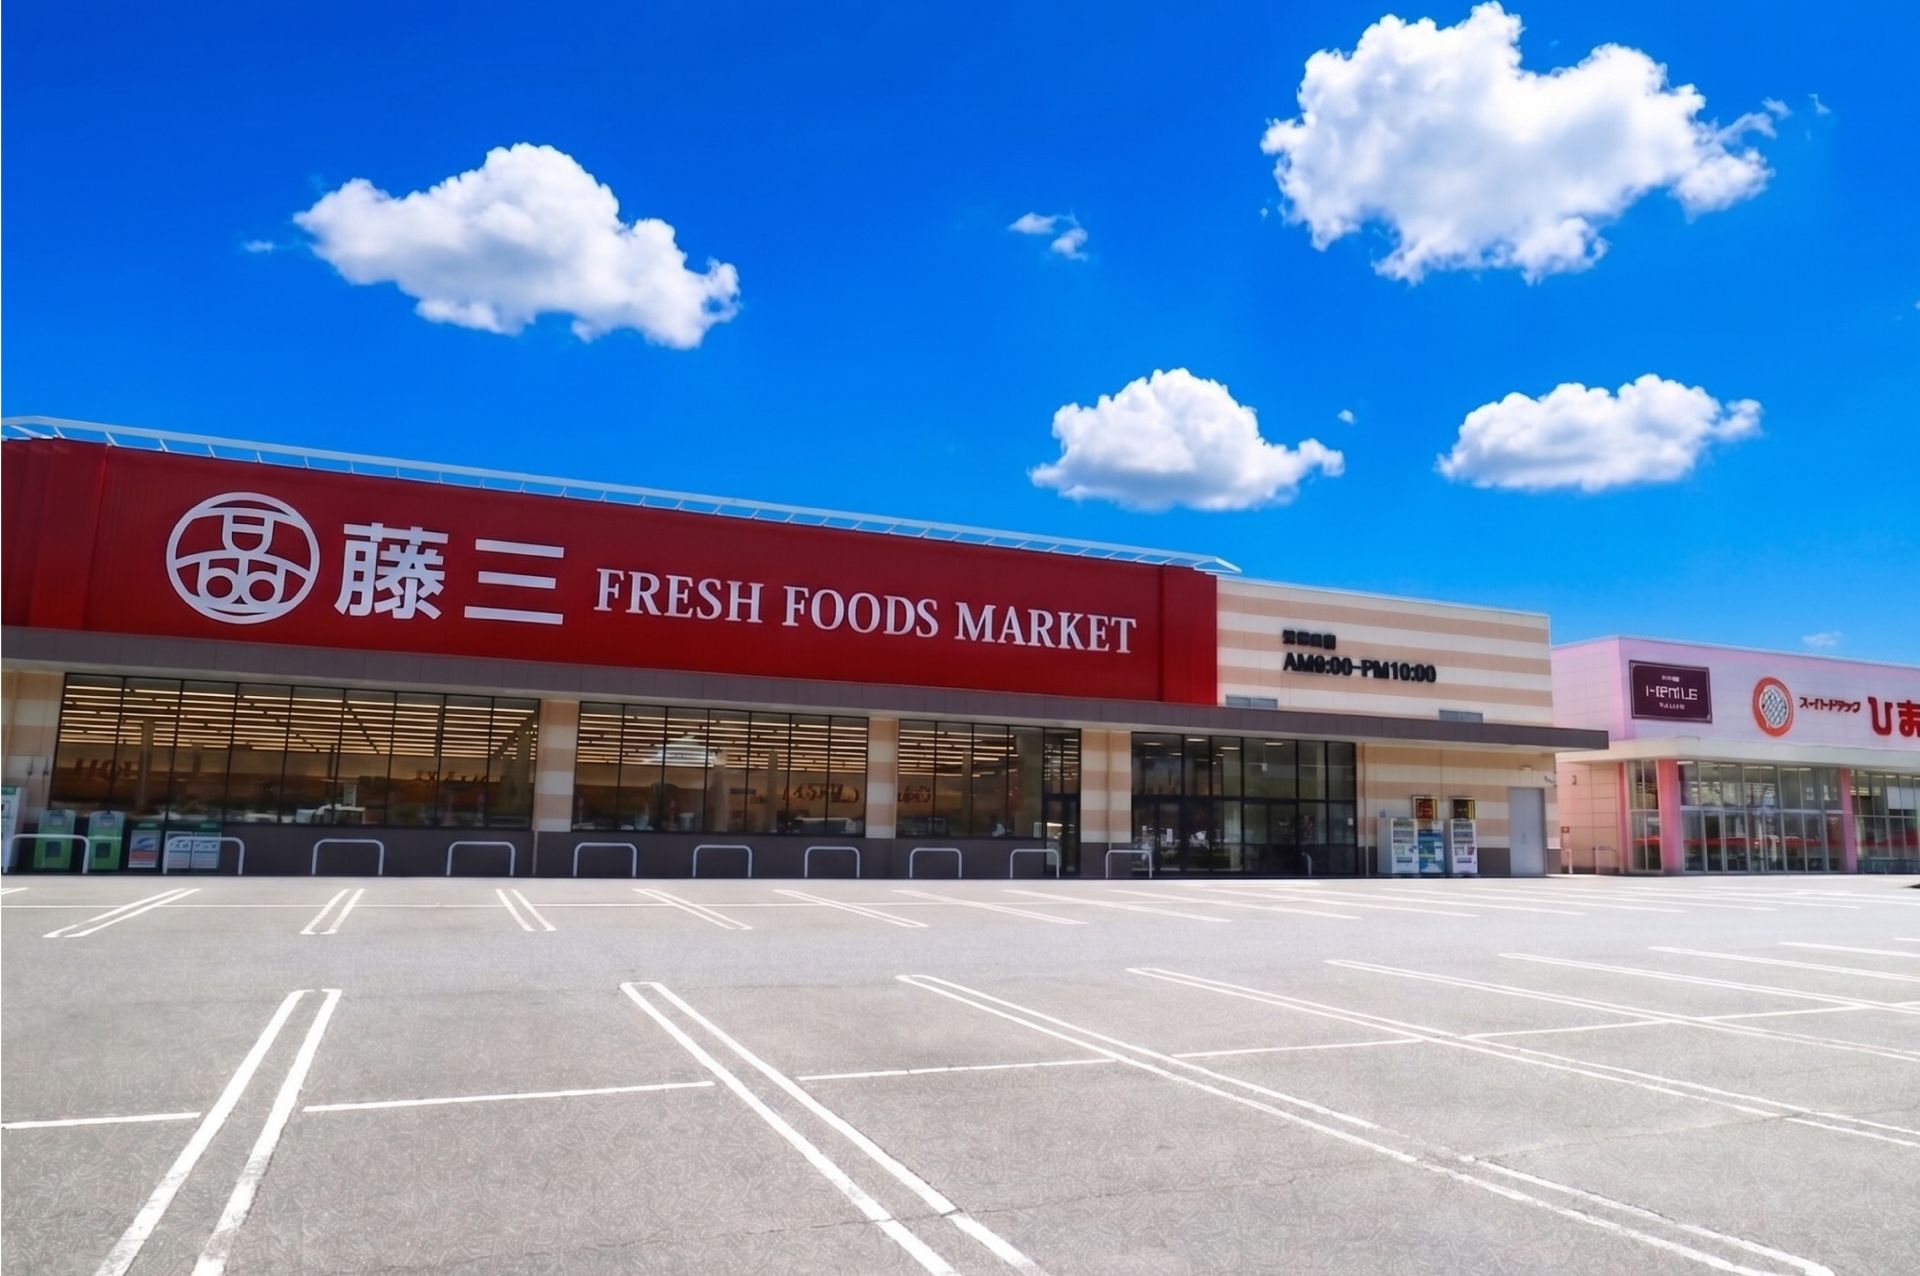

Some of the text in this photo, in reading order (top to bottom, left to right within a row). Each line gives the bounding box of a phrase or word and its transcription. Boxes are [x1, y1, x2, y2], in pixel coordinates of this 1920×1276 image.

[333, 522, 565, 625] 藤三
[593, 567, 1137, 655] FRESH FOODS MARKET
